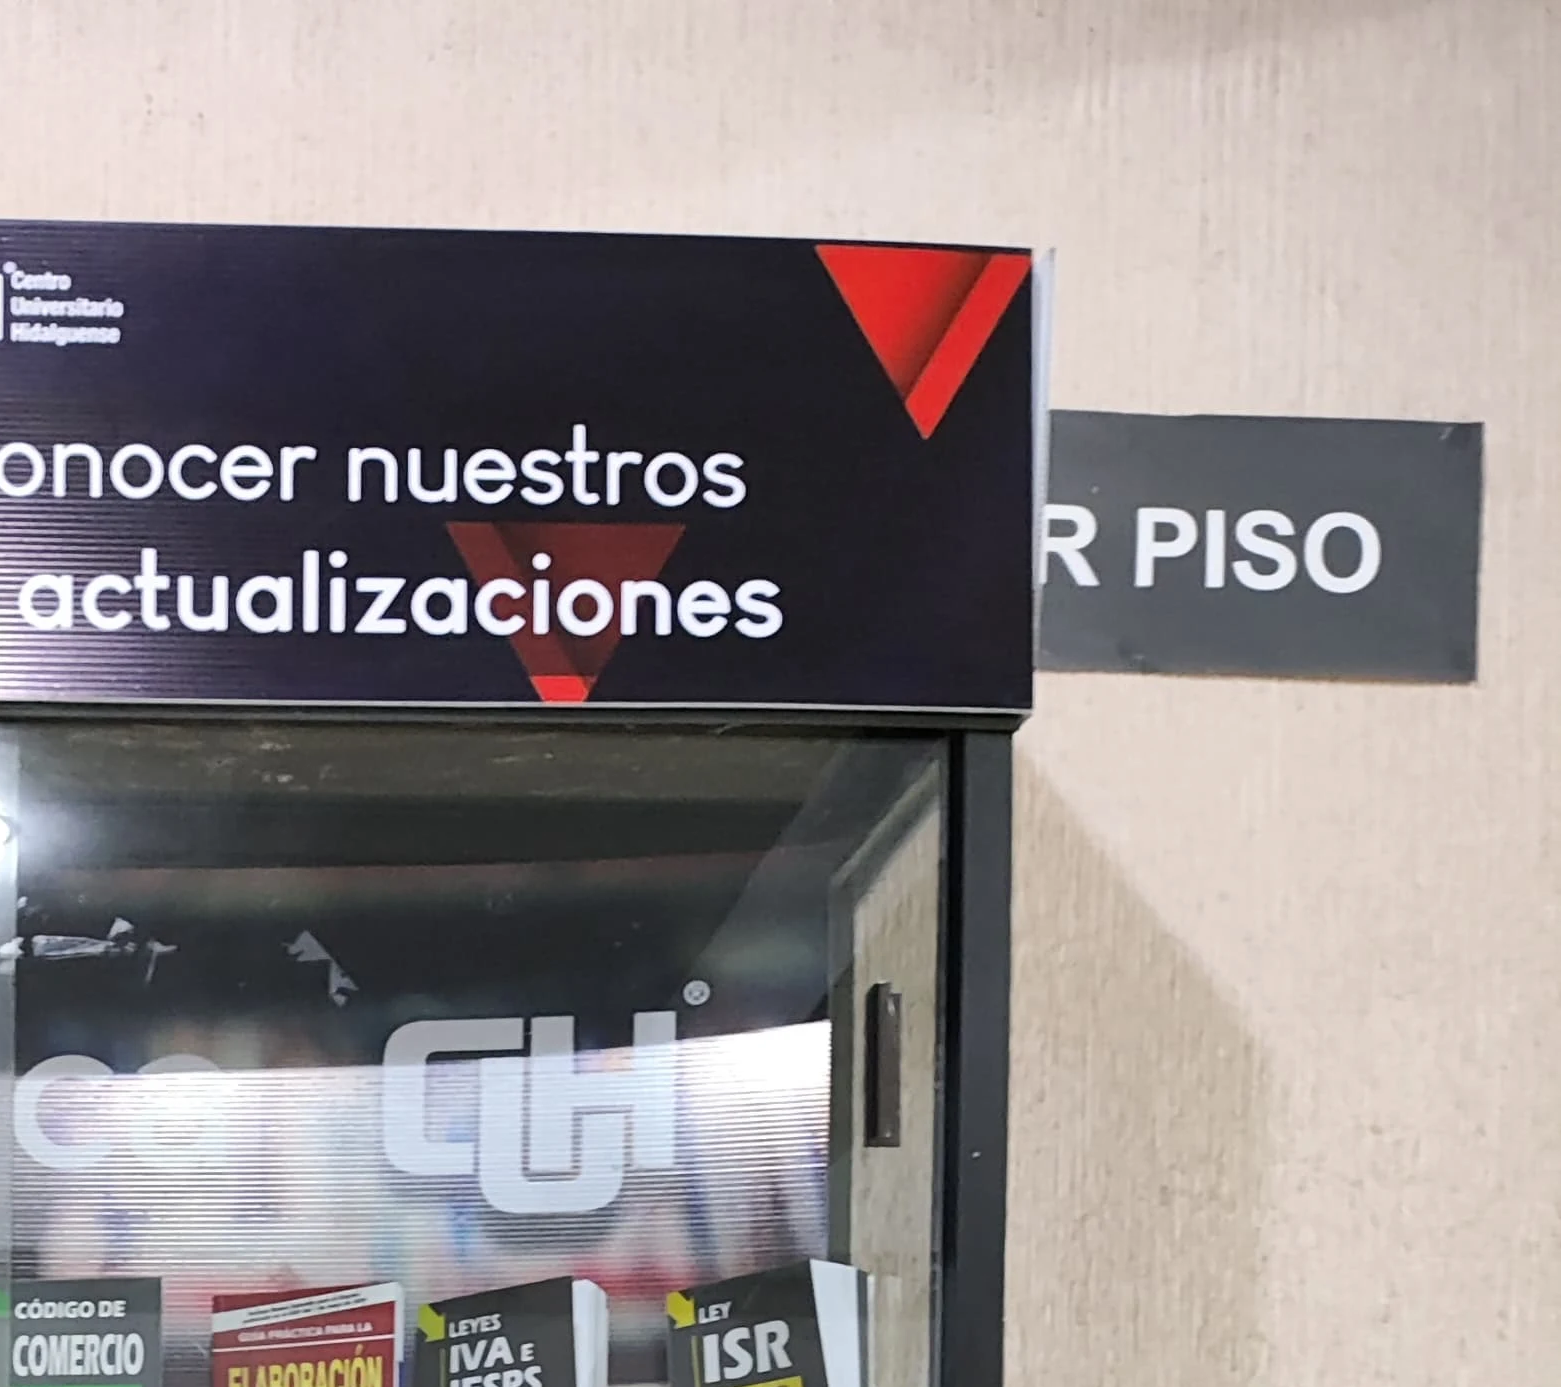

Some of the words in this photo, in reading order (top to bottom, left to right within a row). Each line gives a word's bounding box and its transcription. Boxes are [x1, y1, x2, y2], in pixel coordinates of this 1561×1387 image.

[10, 296, 124, 317] Universitario
[10, 322, 121, 346] Hidalguense
[346, 423, 748, 510] nuestros
[1133, 506, 1382, 594] PISO
[16, 546, 785, 640] actualizaciones
[13, 1297, 96, 1320] CÓDIGO
[97, 1299, 128, 1319] DE
[448, 1313, 502, 1339] LEYES
[698, 1300, 733, 1325] LEY
[11, 1332, 145, 1377] COMERCIO
[448, 1335, 516, 1374] IVA
[520, 1342, 535, 1363] E
[702, 1319, 792, 1384] ISR
